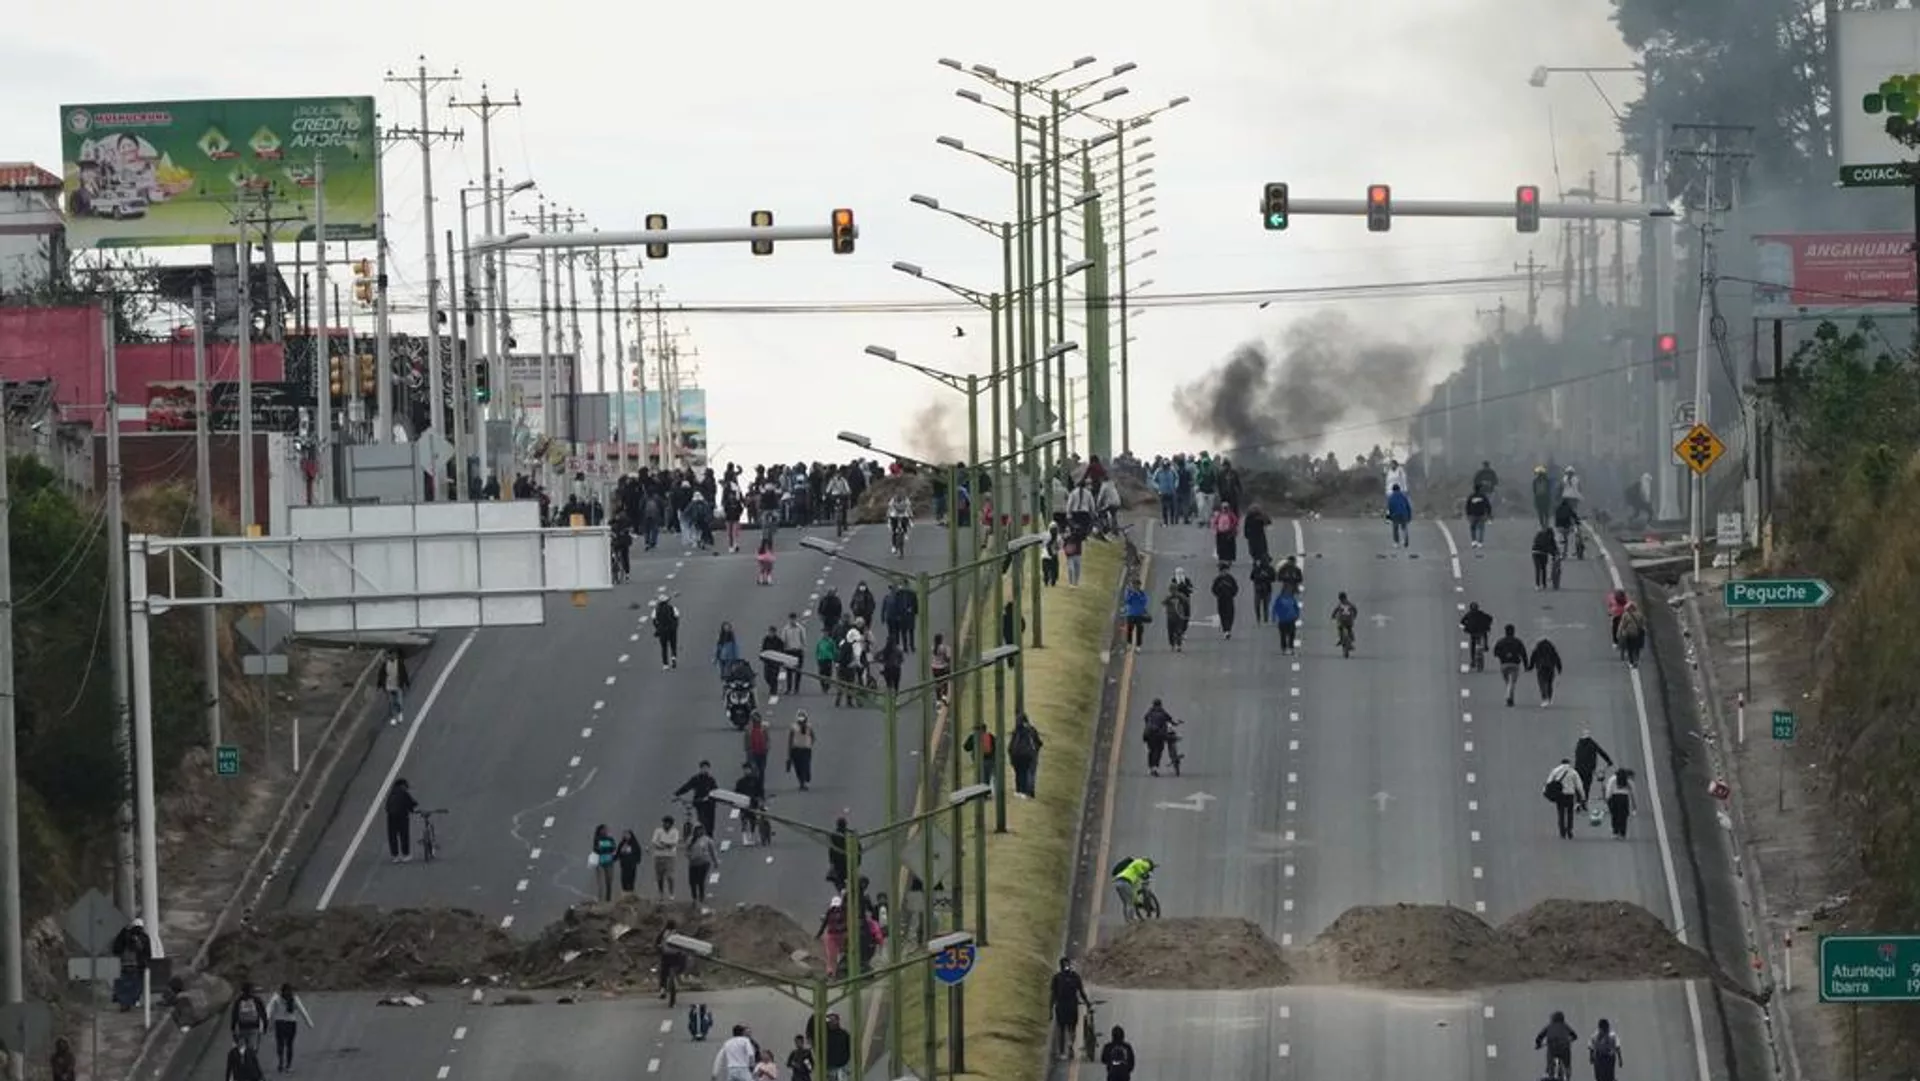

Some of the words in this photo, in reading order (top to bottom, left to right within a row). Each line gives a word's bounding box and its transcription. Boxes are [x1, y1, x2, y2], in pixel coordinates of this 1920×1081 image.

[1734, 585, 1807, 604] Peguche
[1832, 964, 1896, 980] Atuntaqui
[1832, 980, 1869, 993] Ibarra
